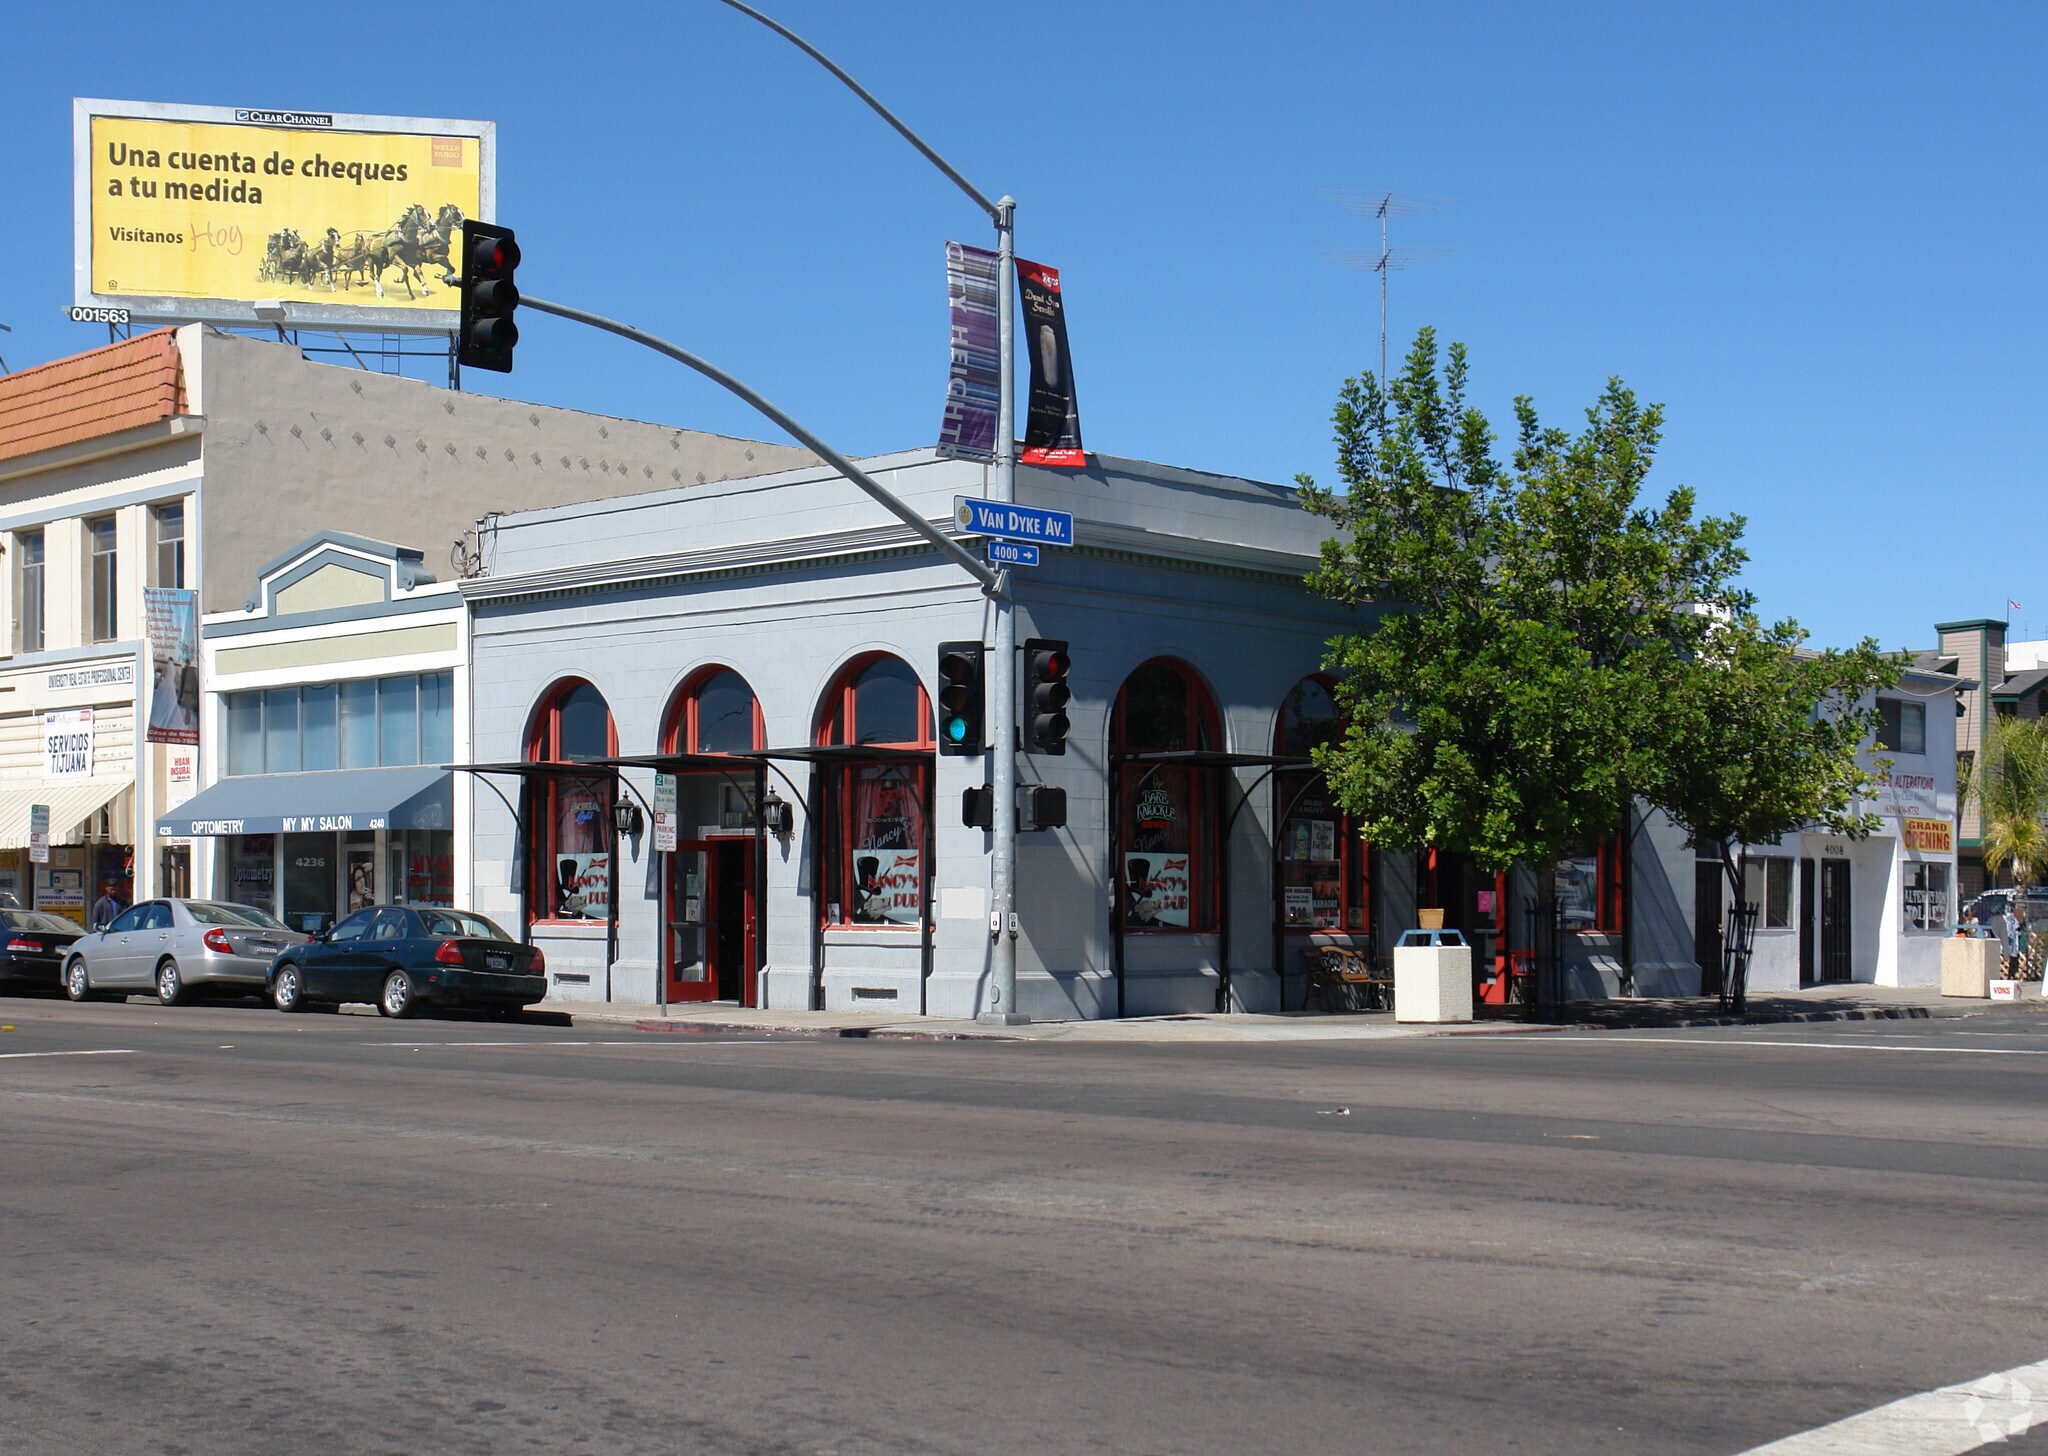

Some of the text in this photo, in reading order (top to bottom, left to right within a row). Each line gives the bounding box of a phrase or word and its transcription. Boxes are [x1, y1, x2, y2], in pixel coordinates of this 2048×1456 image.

[108, 141, 408, 186] Una cuenta de cheques
[434, 151, 460, 159] FARGO
[107, 176, 263, 205] a tu medida
[109, 221, 243, 256] Visítanos Hoy
[71, 307, 129, 324] 001563
[978, 507, 1065, 538] VAN DYKE AV.
[994, 545, 1019, 560] 4000
[47, 732, 89, 754] SERVICIOS
[52, 752, 87, 774] TIJUANA
[656, 774, 663, 785] 2
[1894, 773, 1934, 791] ALTERATIONS
[656, 787, 675, 796] PARKING
[1142, 789, 1169, 804] BARE
[1136, 803, 1176, 821] KNUCKLE
[159, 826, 173, 836] 4236
[191, 815, 385, 835] OPTOMETRY MY MY SALON 4240
[656, 825, 675, 833] PARKING
[1908, 820, 1947, 832] GRAND
[862, 820, 910, 850] Nancy's
[1905, 830, 1950, 851] OPENING
[1824, 844, 1844, 856] 4008
[295, 857, 325, 867] 4236
[233, 863, 274, 886] Optometry
[568, 873, 609, 891] NANCY'S
[868, 873, 919, 891] NANCY'S
[893, 892, 919, 908] PUB
[1163, 895, 1188, 911] PUB
[830, 908, 838, 919] A
[1993, 986, 2011, 995] VONS
